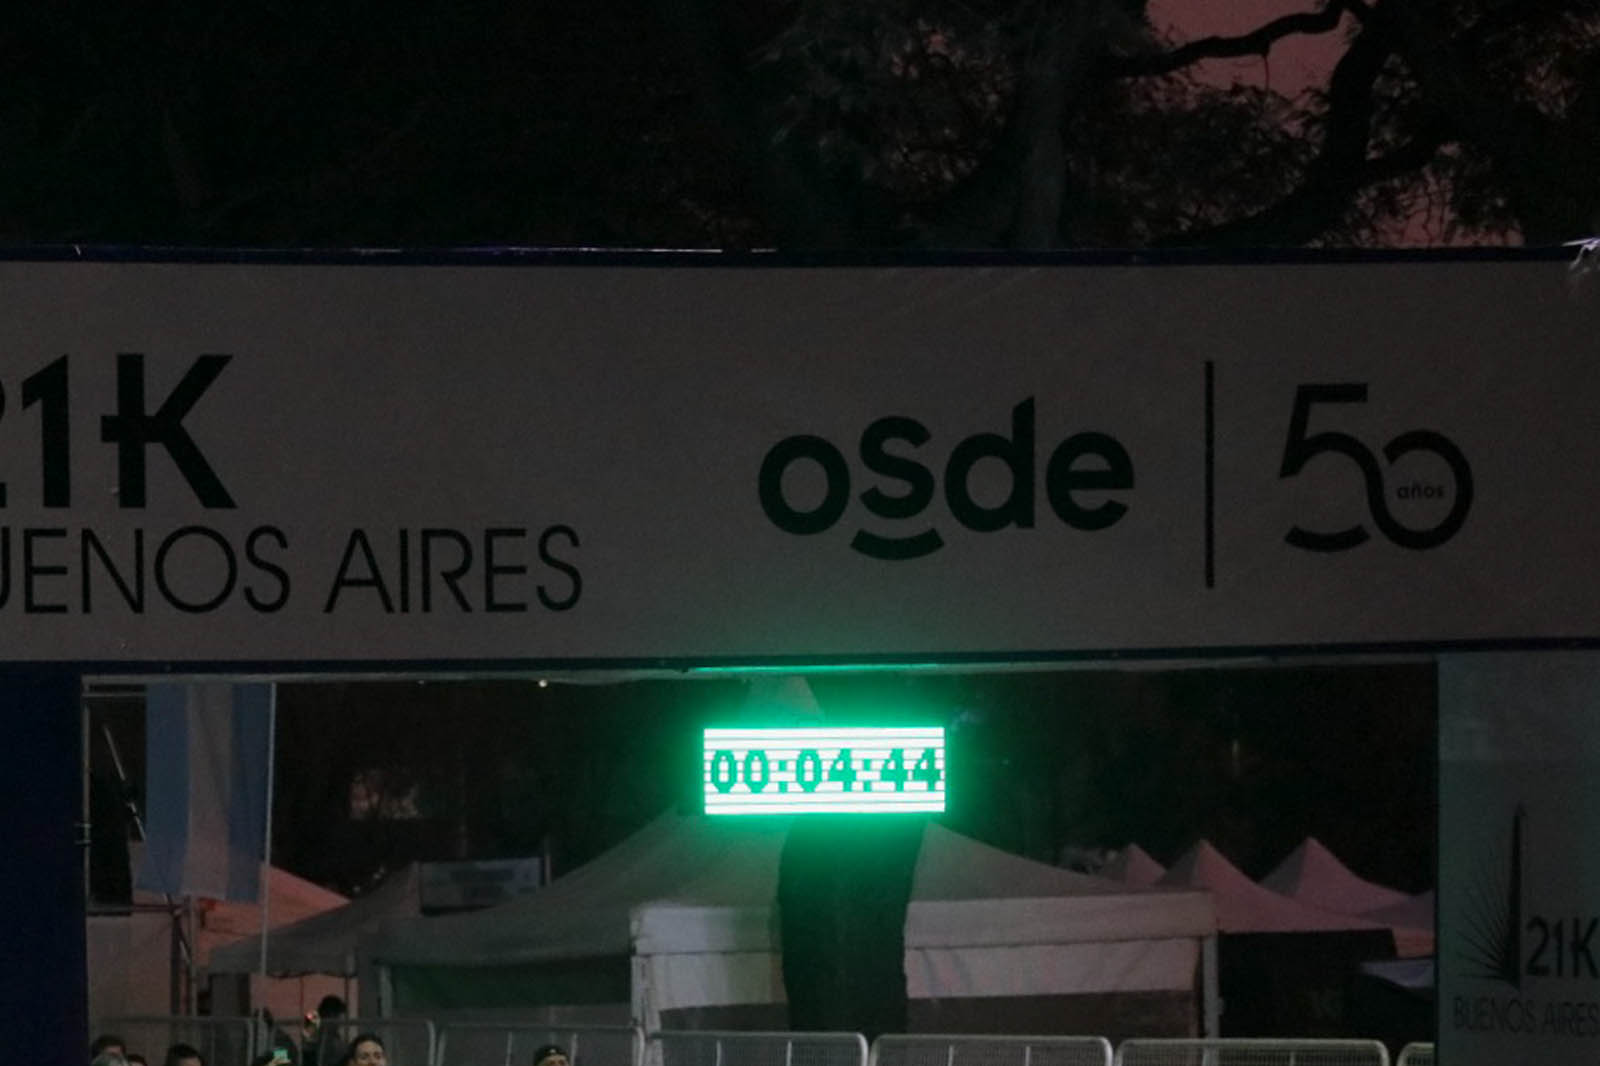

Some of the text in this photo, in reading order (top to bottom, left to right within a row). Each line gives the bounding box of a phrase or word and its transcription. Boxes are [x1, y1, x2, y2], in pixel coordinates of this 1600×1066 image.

[759, 395, 1134, 560] osde
[1280, 384, 1473, 550] 50
[1397, 480, 1445, 499] años
[325, 525, 581, 614] AIRES
[711, 748, 941, 793] 00:04:44
[1527, 916, 1599, 979] 21K
[1453, 996, 1536, 1033] BUENOS
